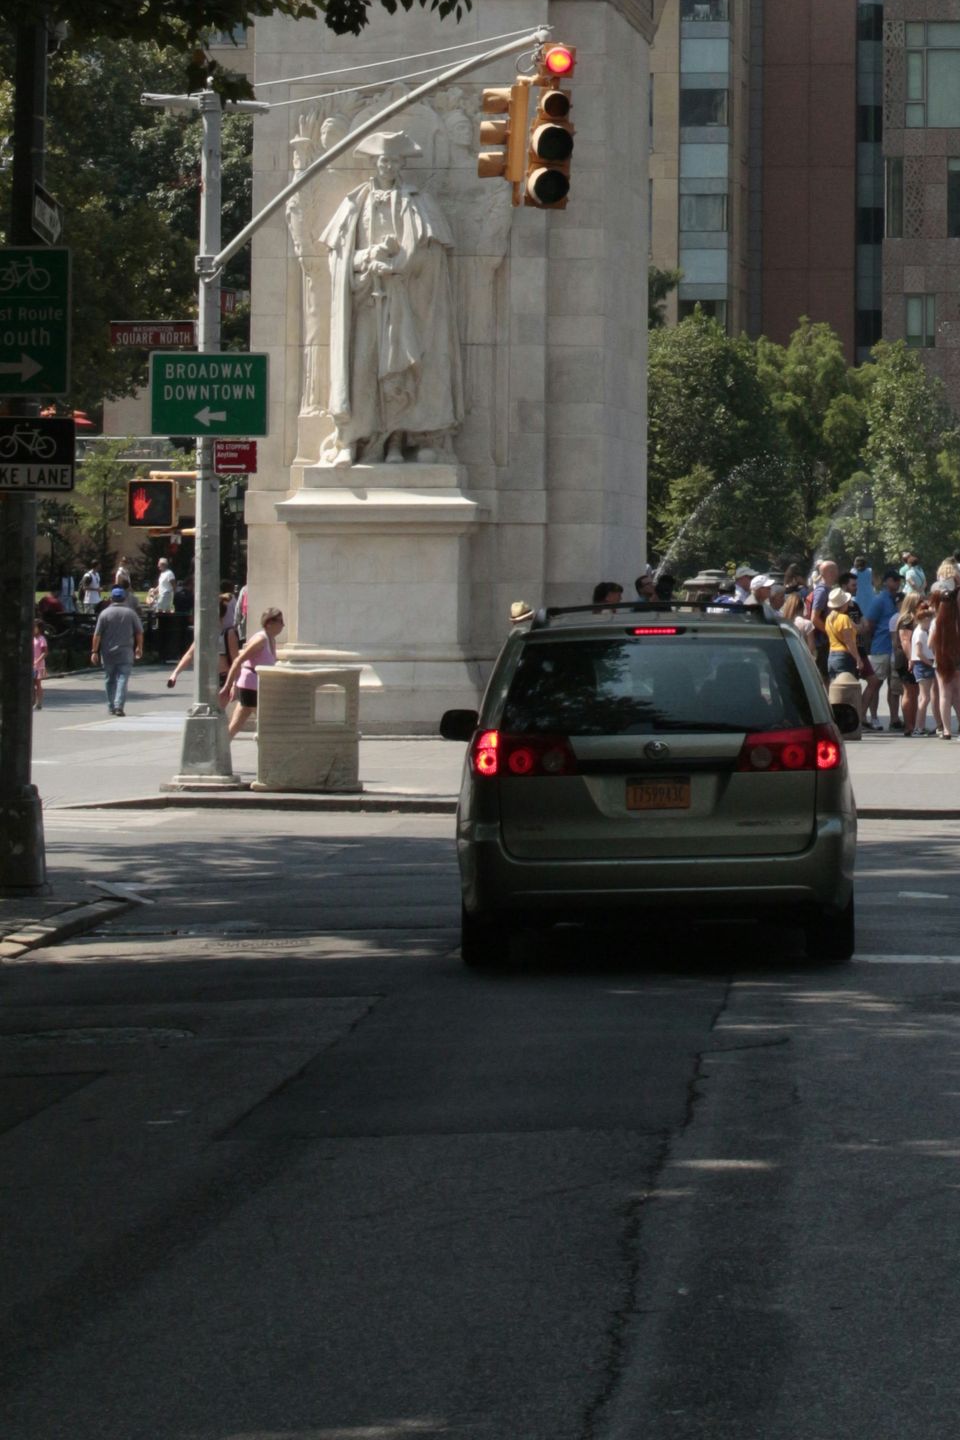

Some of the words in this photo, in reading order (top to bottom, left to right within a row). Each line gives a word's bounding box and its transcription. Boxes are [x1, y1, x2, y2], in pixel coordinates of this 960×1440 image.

[18, 306, 64, 321] Route
[0, 327, 50, 346] outh
[116, 332, 153, 345] SQUARE
[160, 331, 191, 344] NORTH
[165, 363, 253, 379] BROADWAY
[164, 385, 256, 400] DOWNTOWN
[27, 467, 69, 485] LANE
